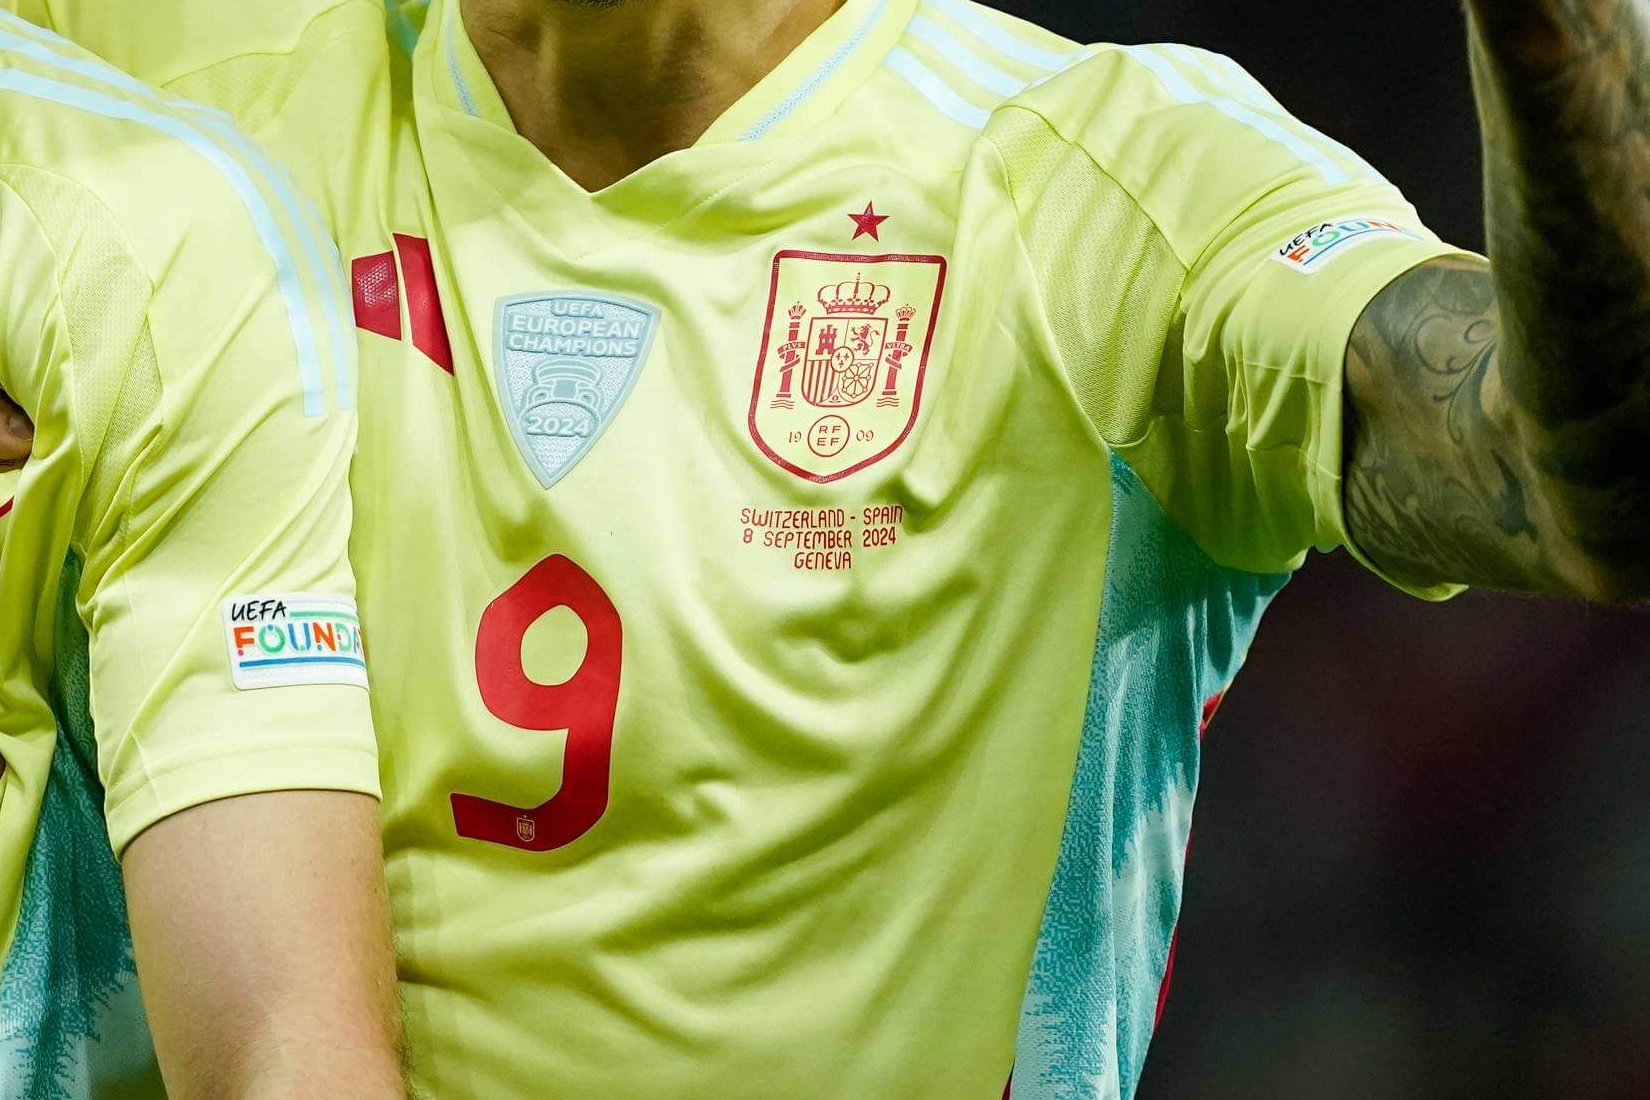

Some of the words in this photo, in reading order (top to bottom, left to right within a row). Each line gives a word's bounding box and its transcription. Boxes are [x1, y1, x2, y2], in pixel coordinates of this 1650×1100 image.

[1280, 223, 1333, 256] UEFA
[554, 301, 604, 316] UEFA
[512, 315, 641, 337] EUROPEAN
[508, 334, 638, 356] CHAMPIONS
[527, 417, 590, 436] 2024
[788, 430, 802, 443] 19
[855, 429, 875, 442] 09
[740, 507, 846, 529] SWITZERLAND
[862, 505, 904, 526] SPAIN
[742, 527, 754, 544] 8
[763, 529, 853, 549] SEPTEMBER
[862, 526, 897, 547] 2024
[794, 551, 853, 570] GENEVA
[231, 599, 287, 621] UEFA
[450, 553, 623, 852] 9
